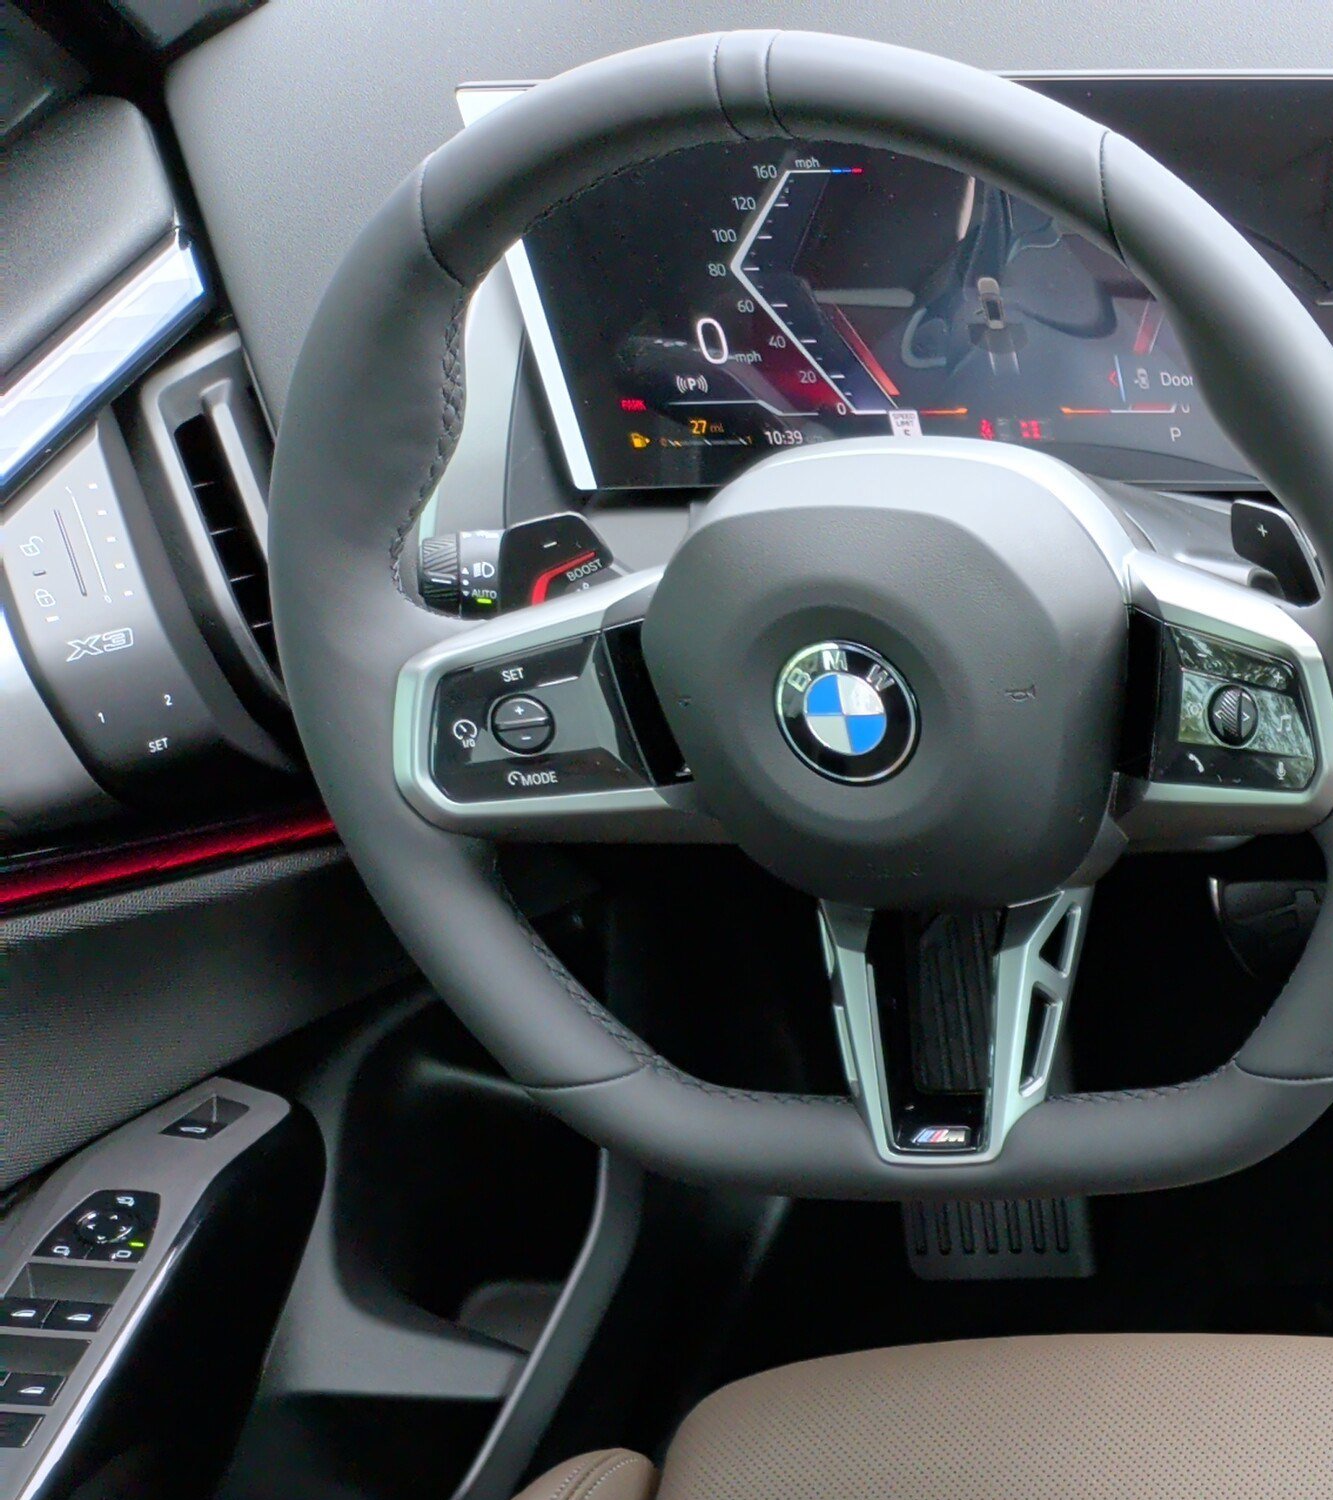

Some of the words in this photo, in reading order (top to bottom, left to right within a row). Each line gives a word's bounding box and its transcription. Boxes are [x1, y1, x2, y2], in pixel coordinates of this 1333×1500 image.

[795, 158, 820, 168] mph
[753, 165, 778, 179] 160
[732, 196, 756, 211] 120
[712, 228, 737, 243] 100
[708, 262, 727, 277] 80
[737, 300, 755, 314] 60
[697, 317, 729, 365] 0
[768, 335, 787, 349] 40
[734, 351, 763, 364] mph
[800, 370, 817, 384] 20
[837, 403, 847, 416] 0
[691, 420, 707, 435] 27
[1169, 427, 1181, 442] P
[765, 430, 803, 446] 10:39
[566, 558, 602, 582] BOOST
[472, 588, 497, 599] AUTO
[66, 627, 134, 662] X3
[502, 668, 524, 682] SET
[787, 651, 894, 692] BMW
[164, 694, 172, 706] 2
[98, 712, 105, 723] 1
[149, 737, 168, 753] SET
[521, 771, 558, 786] MODE
